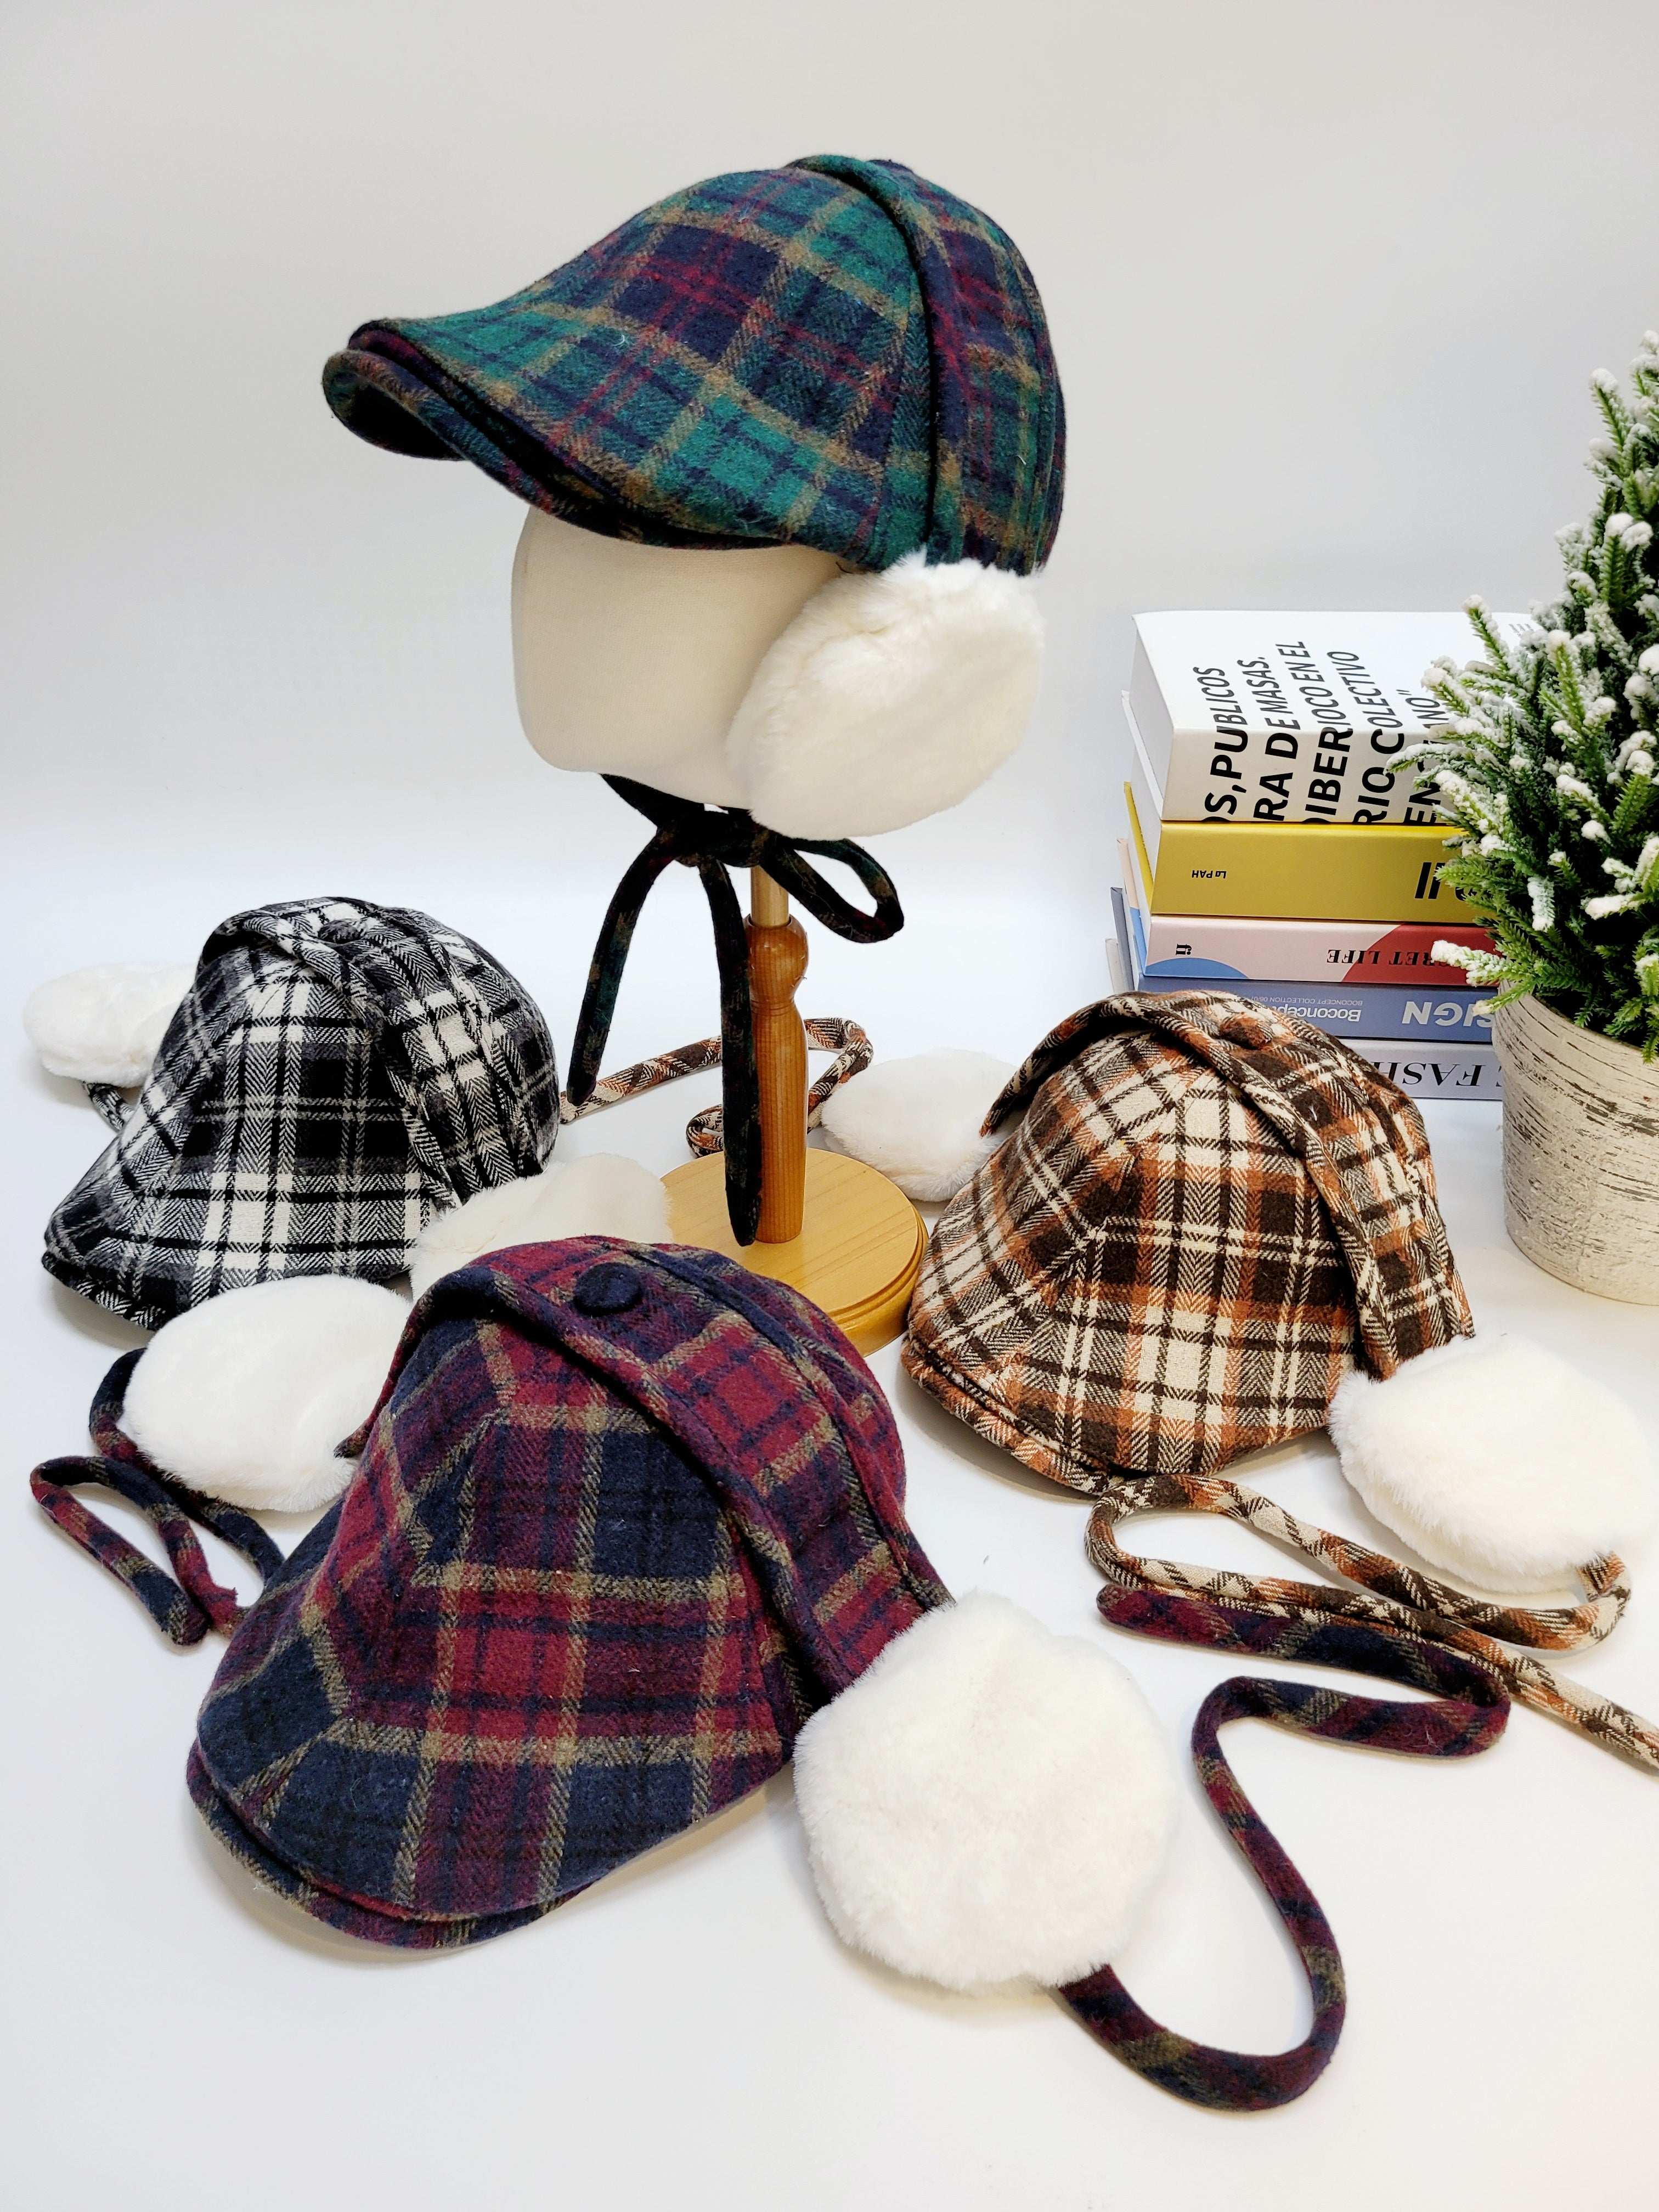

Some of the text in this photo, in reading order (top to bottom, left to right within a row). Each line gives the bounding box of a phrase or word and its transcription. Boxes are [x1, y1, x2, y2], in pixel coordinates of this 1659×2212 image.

[1237, 657, 1294, 714] MASAS.
[1327, 651, 1405, 754] COLECTIVO
[1264, 717, 1301, 759] DE
[1275, 641, 1353, 824] IBERIOCO EN EL
[1192, 870, 1213, 878] PAH
[1327, 949, 1380, 964] LIFE
[1269, 996, 1316, 1005] COLLECTION
[1272, 1003, 1362, 1022] Boconcep
